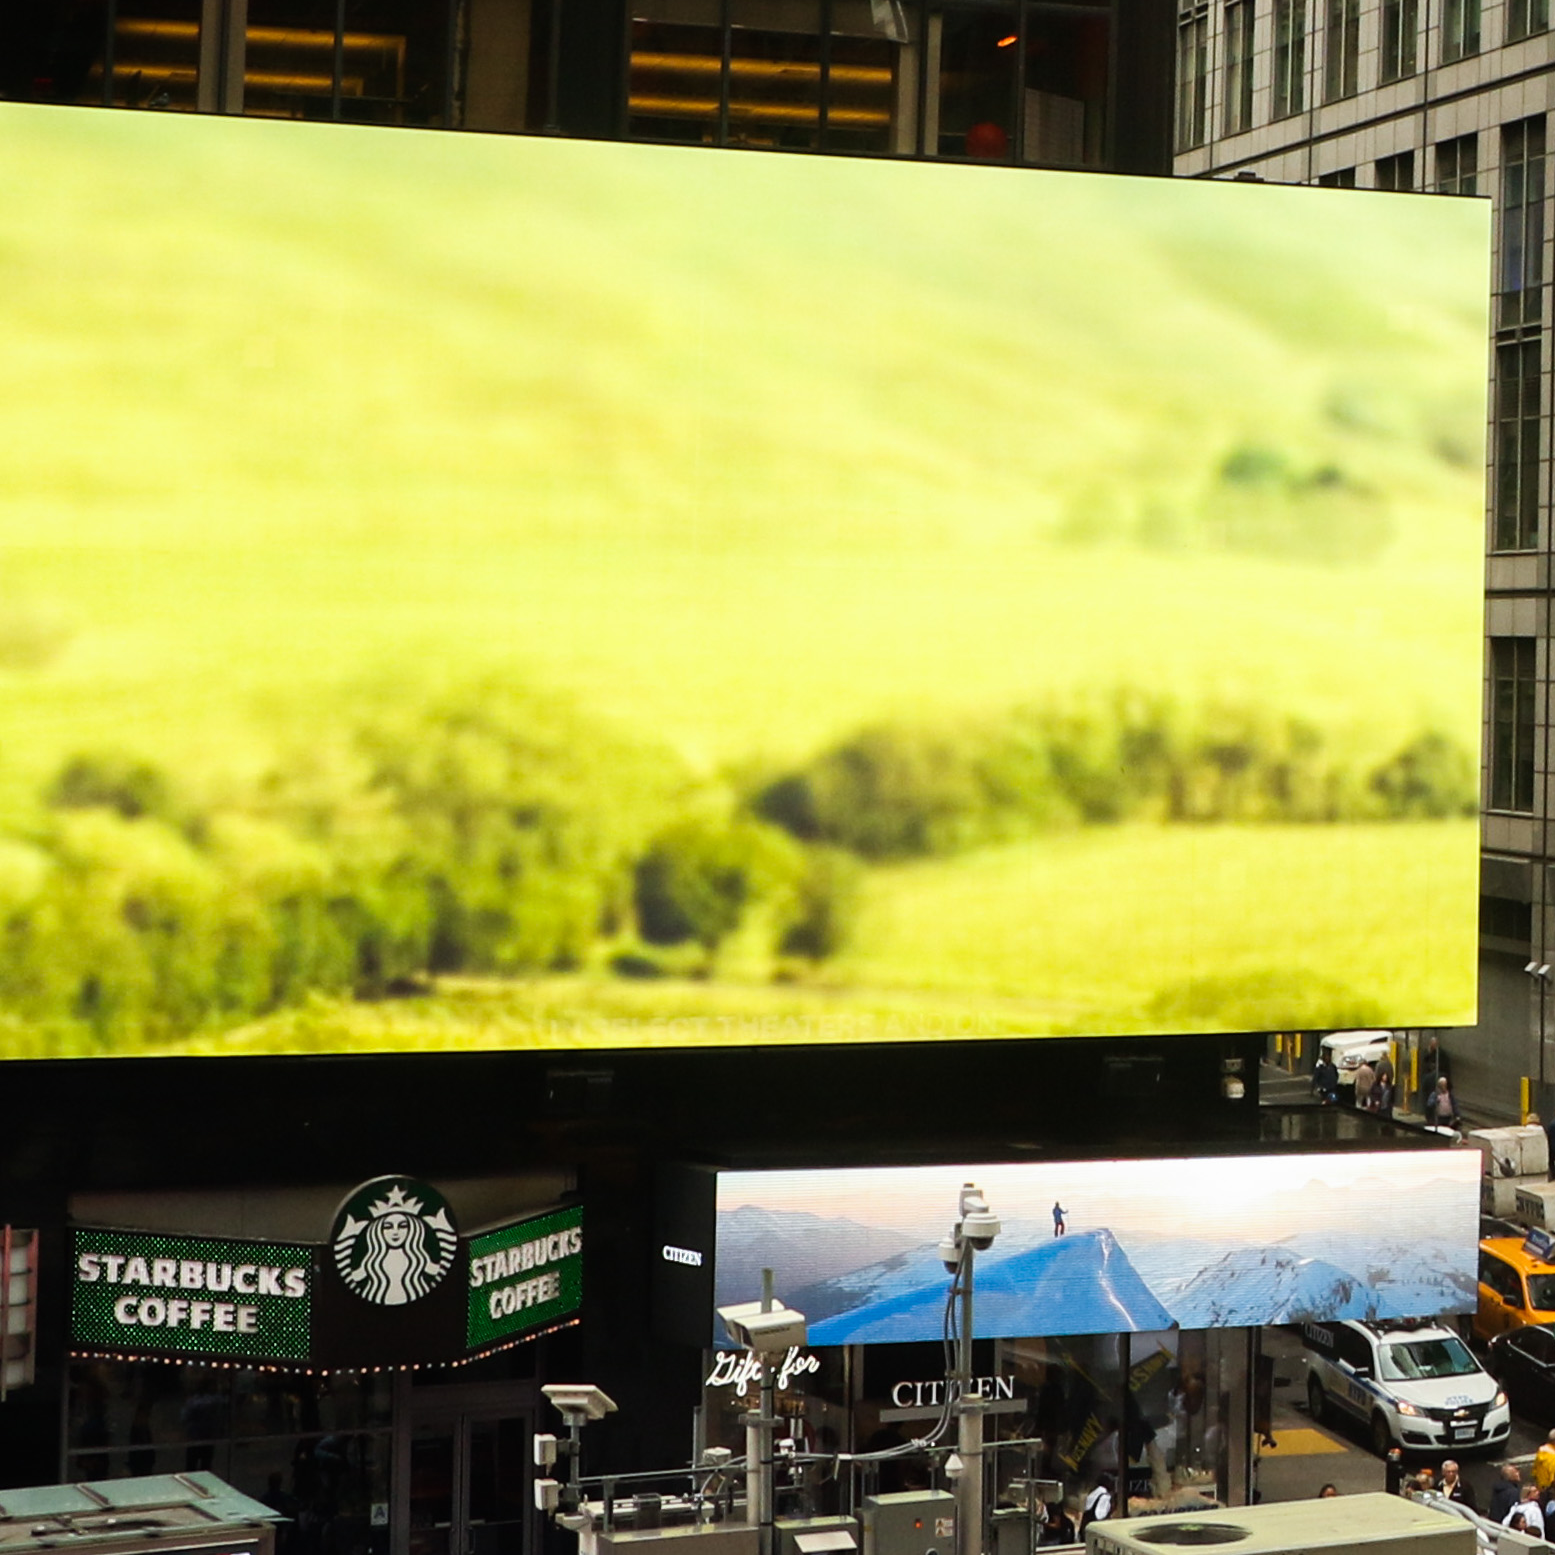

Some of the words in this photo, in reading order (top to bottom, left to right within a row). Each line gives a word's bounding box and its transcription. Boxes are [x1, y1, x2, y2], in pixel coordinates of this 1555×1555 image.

[78, 1253, 306, 1299] STARBUCKS
[468, 1225, 582, 1288] STARBUCKS
[662, 1245, 702, 1267] CITIZEN
[114, 1295, 259, 1334] COFFEE
[489, 1270, 561, 1319] COFFEE
